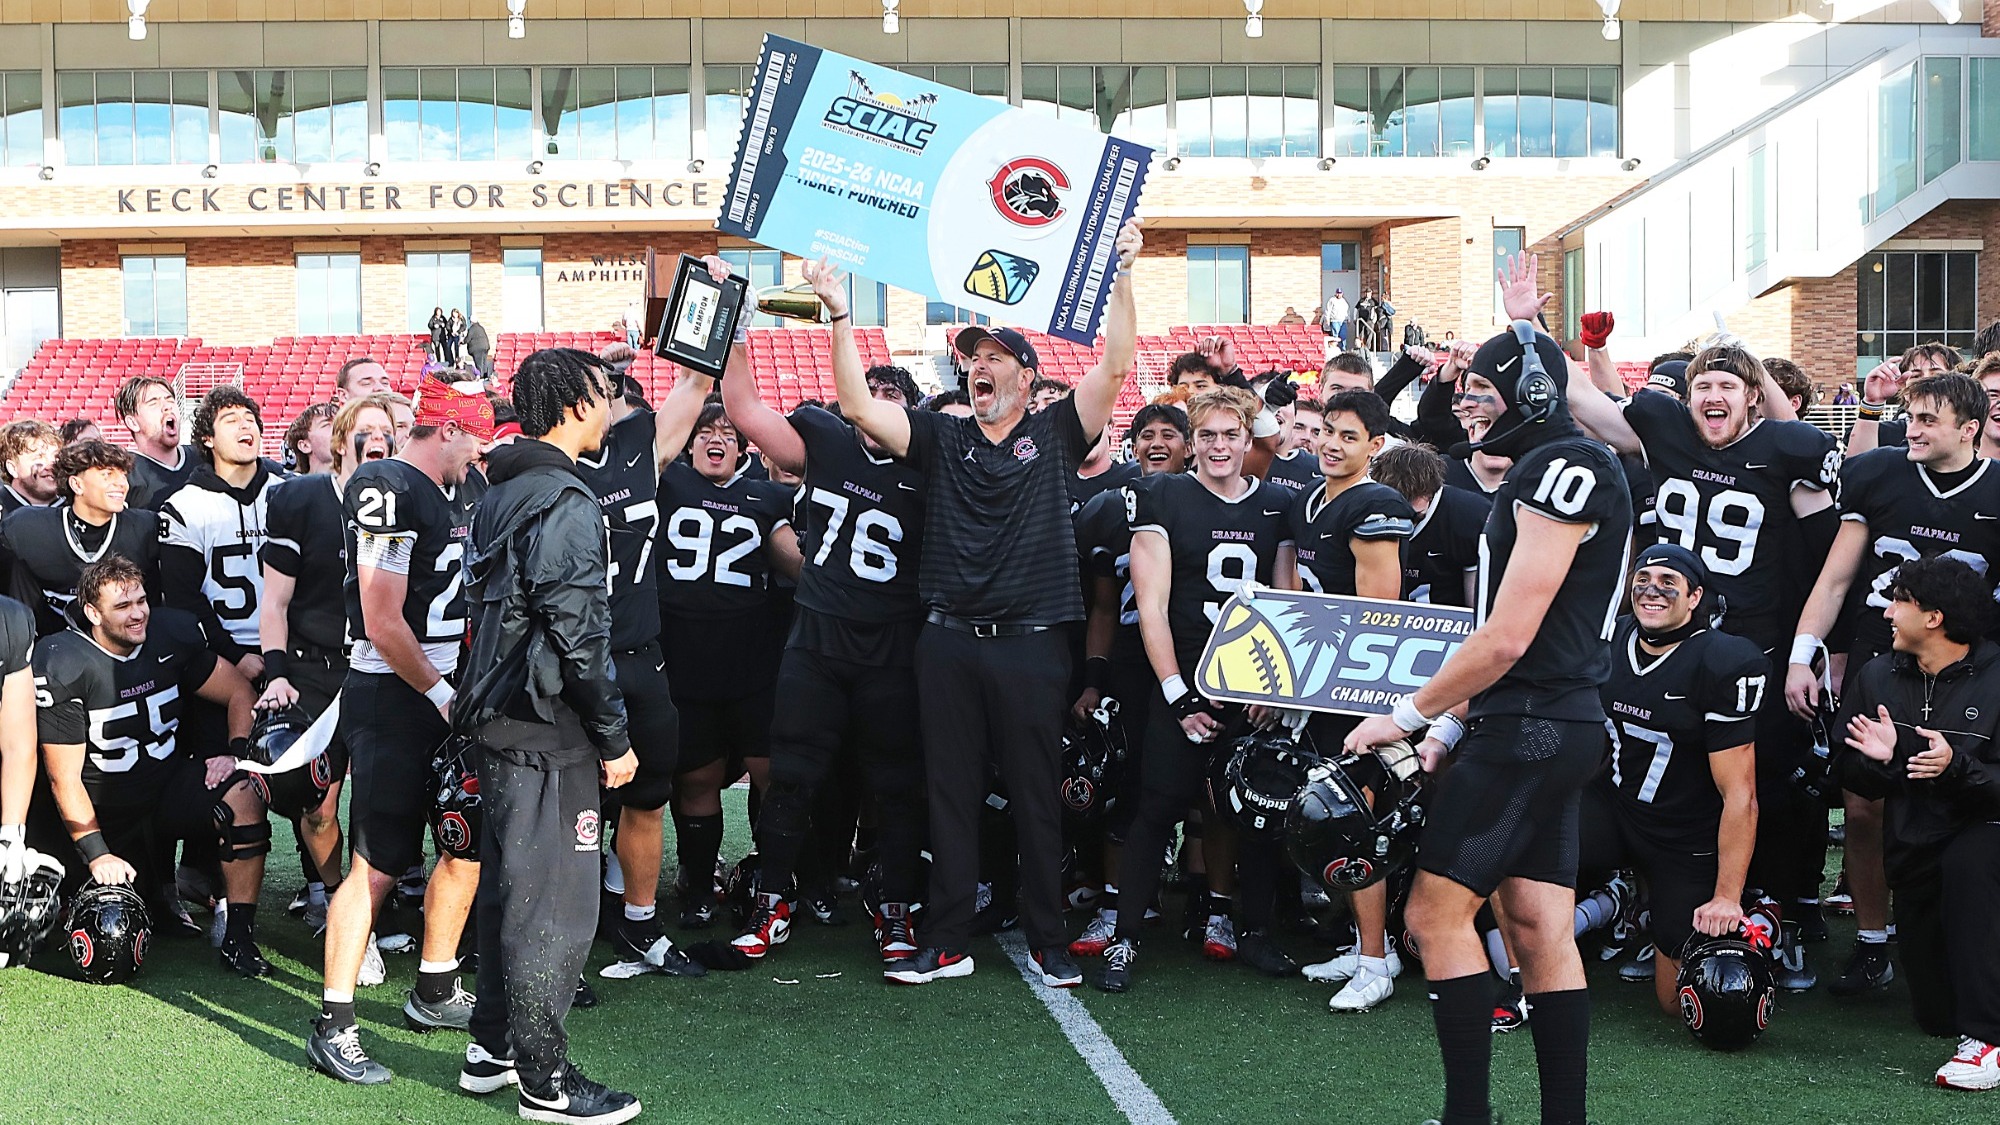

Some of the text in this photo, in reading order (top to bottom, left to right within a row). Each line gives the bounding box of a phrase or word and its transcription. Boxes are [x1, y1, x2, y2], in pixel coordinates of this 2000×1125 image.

[783, 64, 794, 84] SEAT
[825, 97, 937, 149] SCIAC
[764, 135, 776, 155] ROW
[800, 147, 925, 200] 2025-26 NCAA
[118, 182, 708, 212] KECK CENTER FOR SCIENCE
[796, 167, 920, 219] TICKET PUNCHED
[744, 201, 758, 232] SECTION
[815, 229, 870, 253] #SCIACtion
[1055, 144, 1120, 331] NCAA TOURNAMENT AUTOMATIC QUALIFIER
[557, 269, 643, 282] AMPHITH
[693, 296, 709, 336] CHAMPION
[715, 307, 730, 341] FOOTBALL
[843, 480, 883, 503] CHAPMAN
[1533, 457, 1597, 516] 10
[1692, 468, 1736, 486] CHAPMAN
[357, 487, 396, 527] 21
[598, 488, 631, 506] APMAN
[702, 500, 738, 513] CHAPMAN
[1126, 490, 1137, 522] 9
[235, 528, 268, 539] CAPA
[811, 487, 904, 583] 76
[1211, 530, 1255, 541] CHAPMAN
[1656, 478, 1765, 577] 99
[1911, 525, 1960, 543] CHAPMAN
[667, 506, 762, 588] 92
[211, 541, 264, 621] 5
[426, 543, 466, 637] 2
[1359, 611, 1402, 628] 2025
[33, 676, 55, 708] 5
[120, 679, 156, 699] CHAPMAN
[1330, 686, 1409, 706] CHAMPIO
[1736, 674, 1766, 712] 17
[1612, 701, 1652, 720] CHAPMAN
[89, 684, 181, 773] 55
[1243, 789, 1289, 811] Riddell
[1253, 816, 1266, 829] 8
